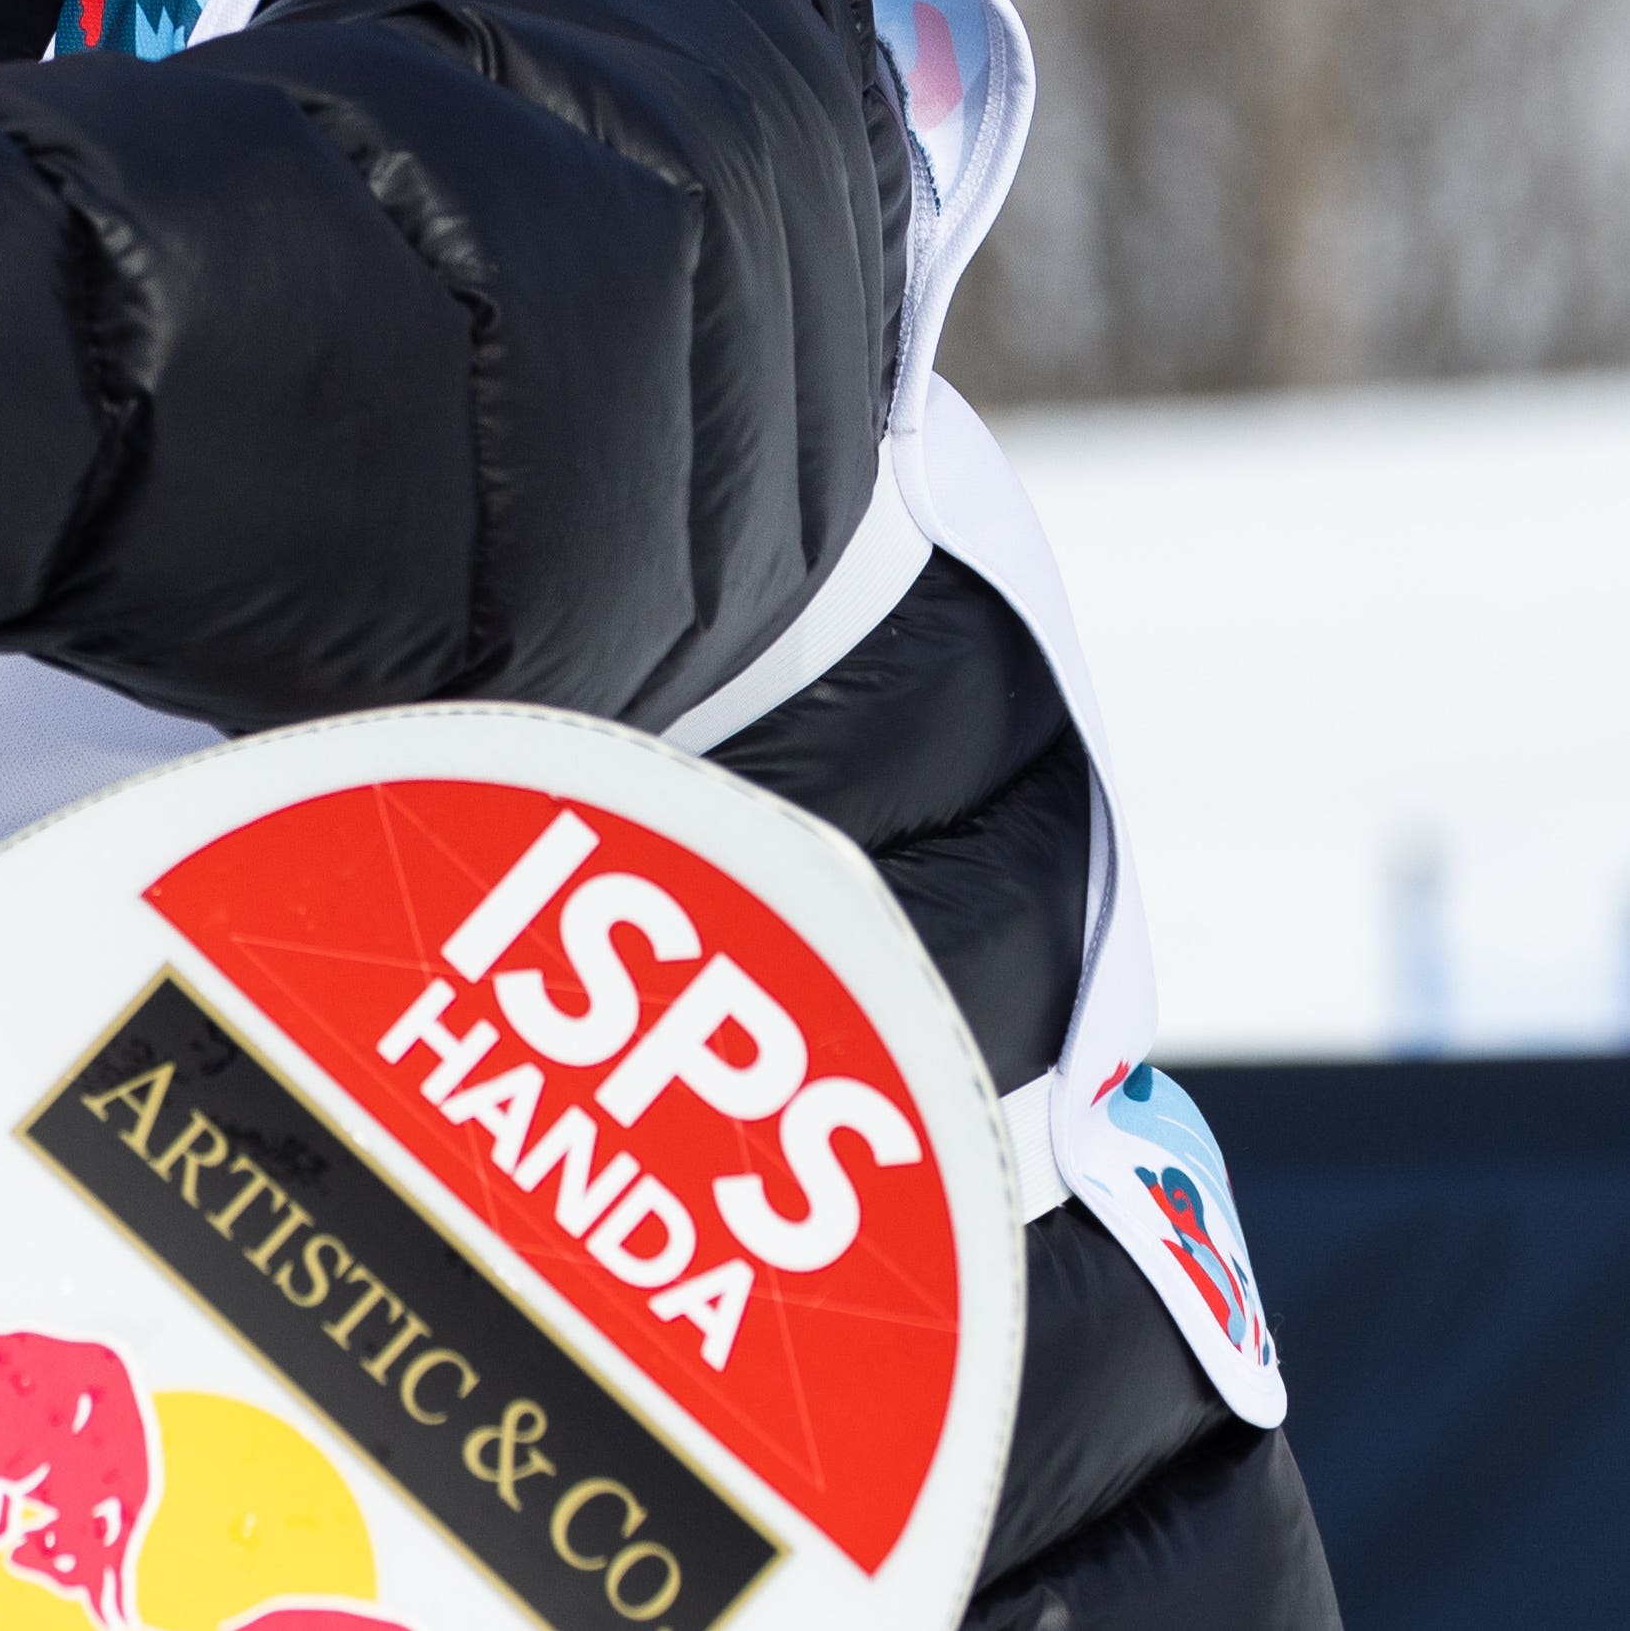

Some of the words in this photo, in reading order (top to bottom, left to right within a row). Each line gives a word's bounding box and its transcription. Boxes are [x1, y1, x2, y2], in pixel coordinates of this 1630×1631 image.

[376, 977, 756, 1373] HANDA
[440, 807, 923, 1274] ISPS
[80, 1061, 481, 1426] ARTISTIC
[462, 1397, 557, 1513] &
